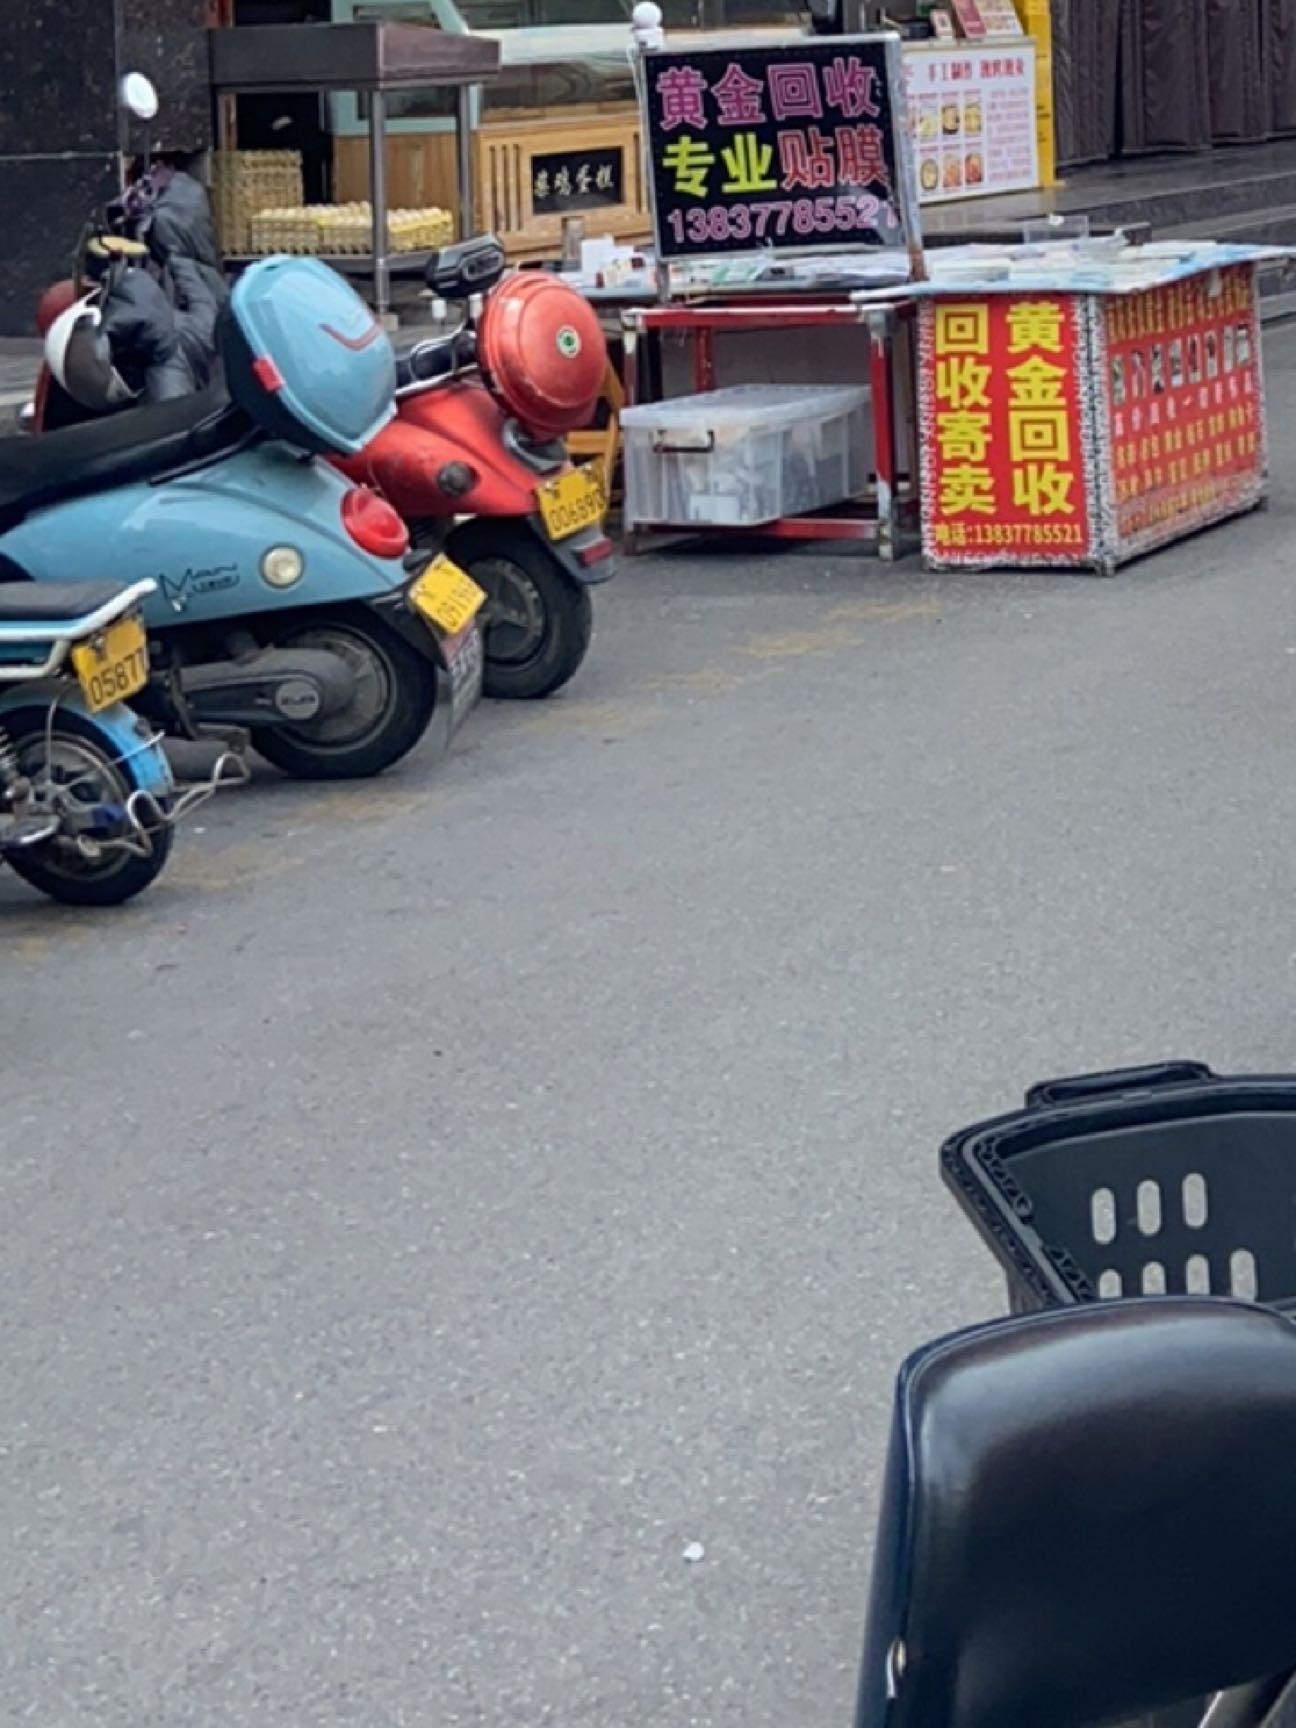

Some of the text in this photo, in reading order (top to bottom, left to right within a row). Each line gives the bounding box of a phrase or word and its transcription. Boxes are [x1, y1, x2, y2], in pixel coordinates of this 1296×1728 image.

[656, 56, 881, 131] 黄金回收
[662, 124, 890, 197] 专业贴膜
[934, 303, 996, 517] 回收寄卖
[1006, 301, 1074, 517] 黄金回收
